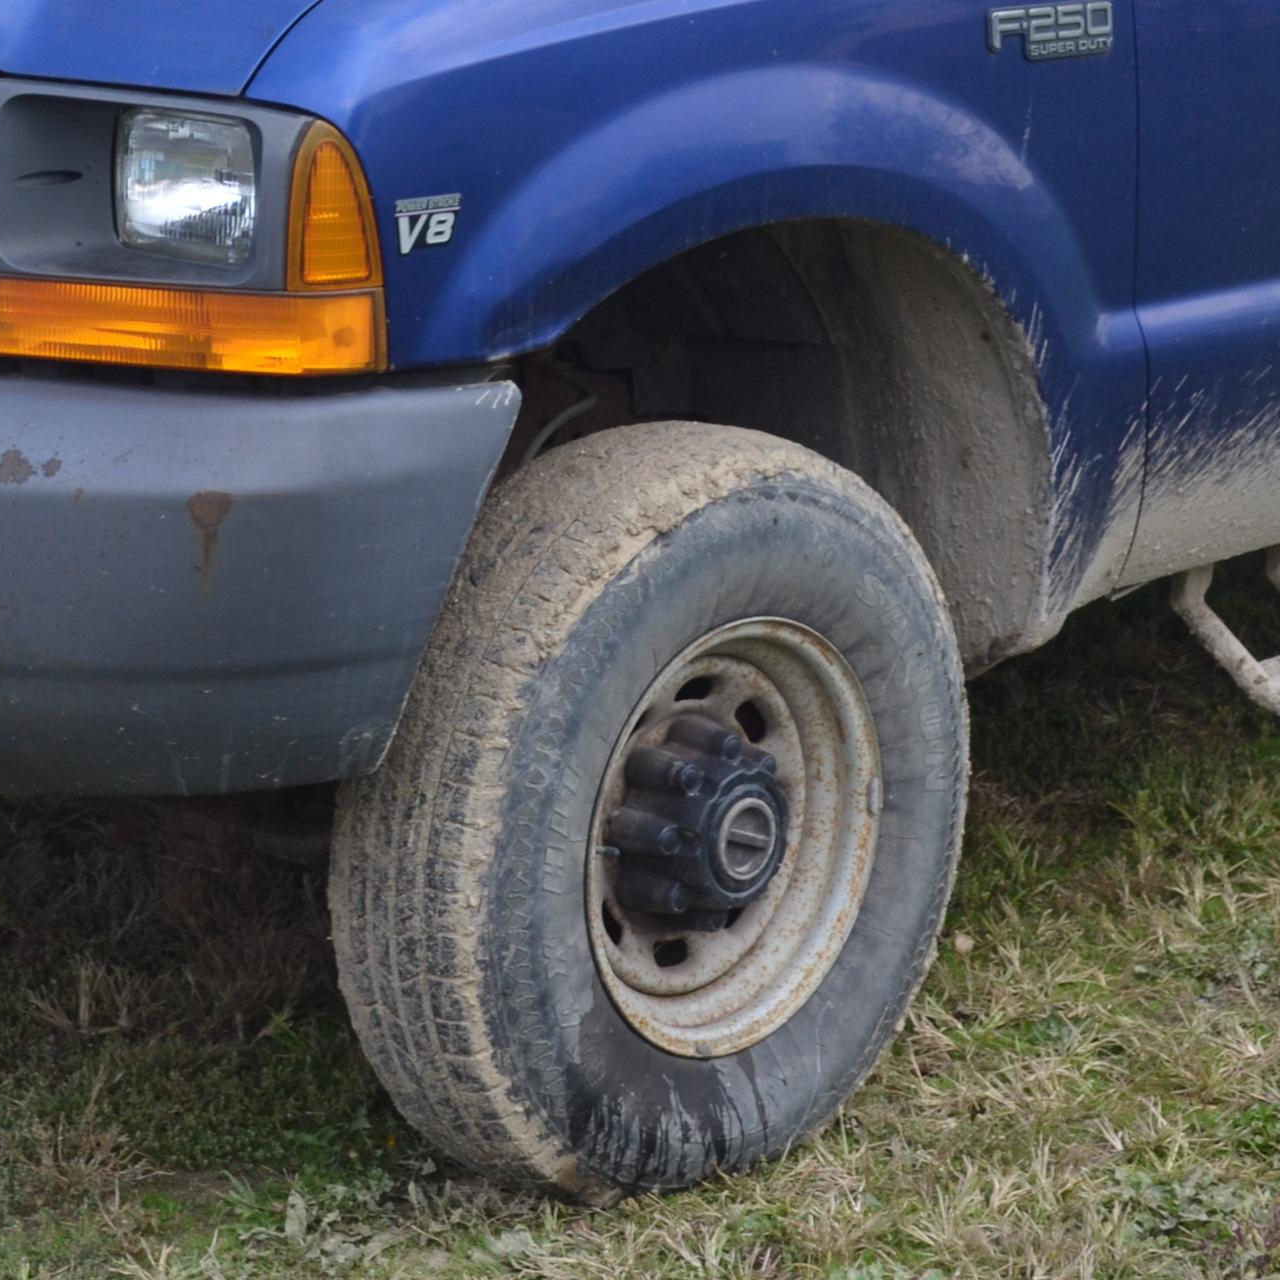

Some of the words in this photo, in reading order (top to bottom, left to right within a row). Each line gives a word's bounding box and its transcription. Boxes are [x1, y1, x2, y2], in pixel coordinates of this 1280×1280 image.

[1030, 41, 1075, 56] SUPER
[1078, 36, 1113, 51] DUTY
[398, 211, 455, 254] V8
